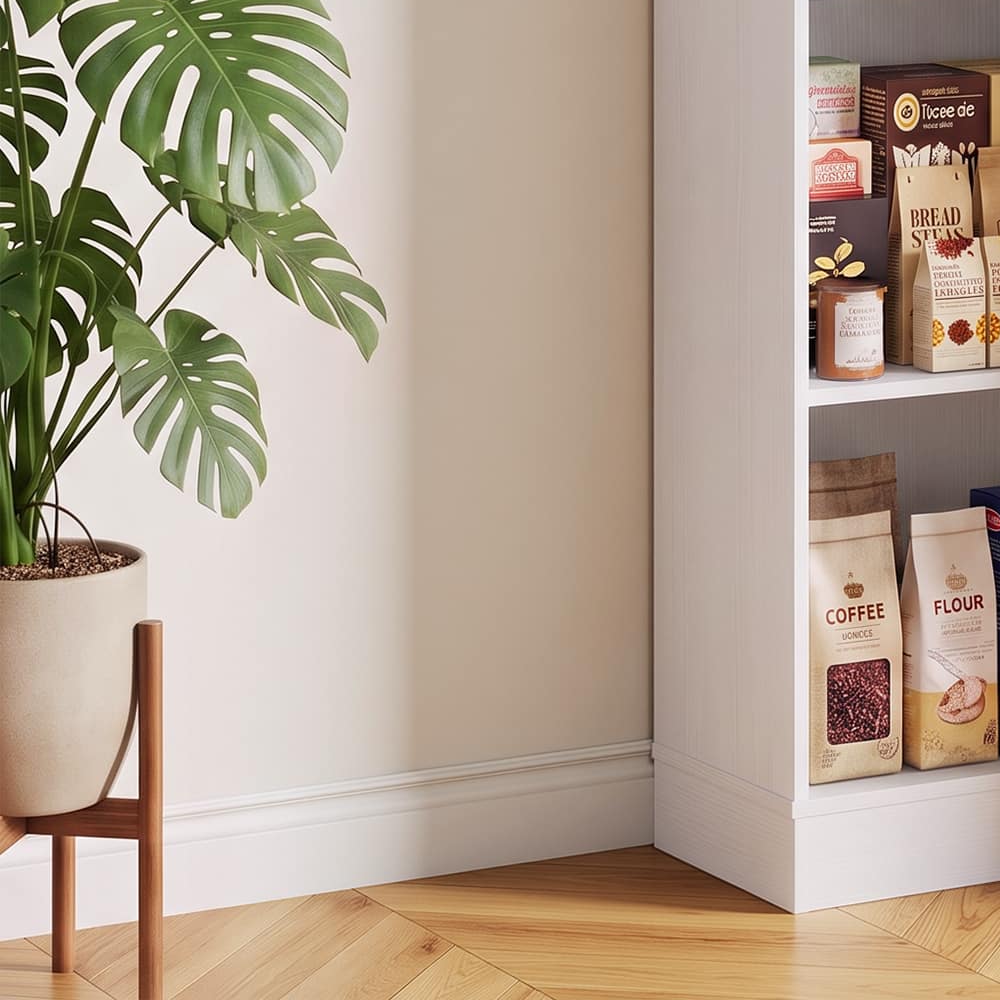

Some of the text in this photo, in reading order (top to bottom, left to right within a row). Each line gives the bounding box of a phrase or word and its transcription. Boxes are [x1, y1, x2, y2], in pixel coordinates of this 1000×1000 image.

[910, 206, 962, 229] BREAD
[825, 602, 886, 626] COFFEE
[933, 594, 985, 616] FLOUR
